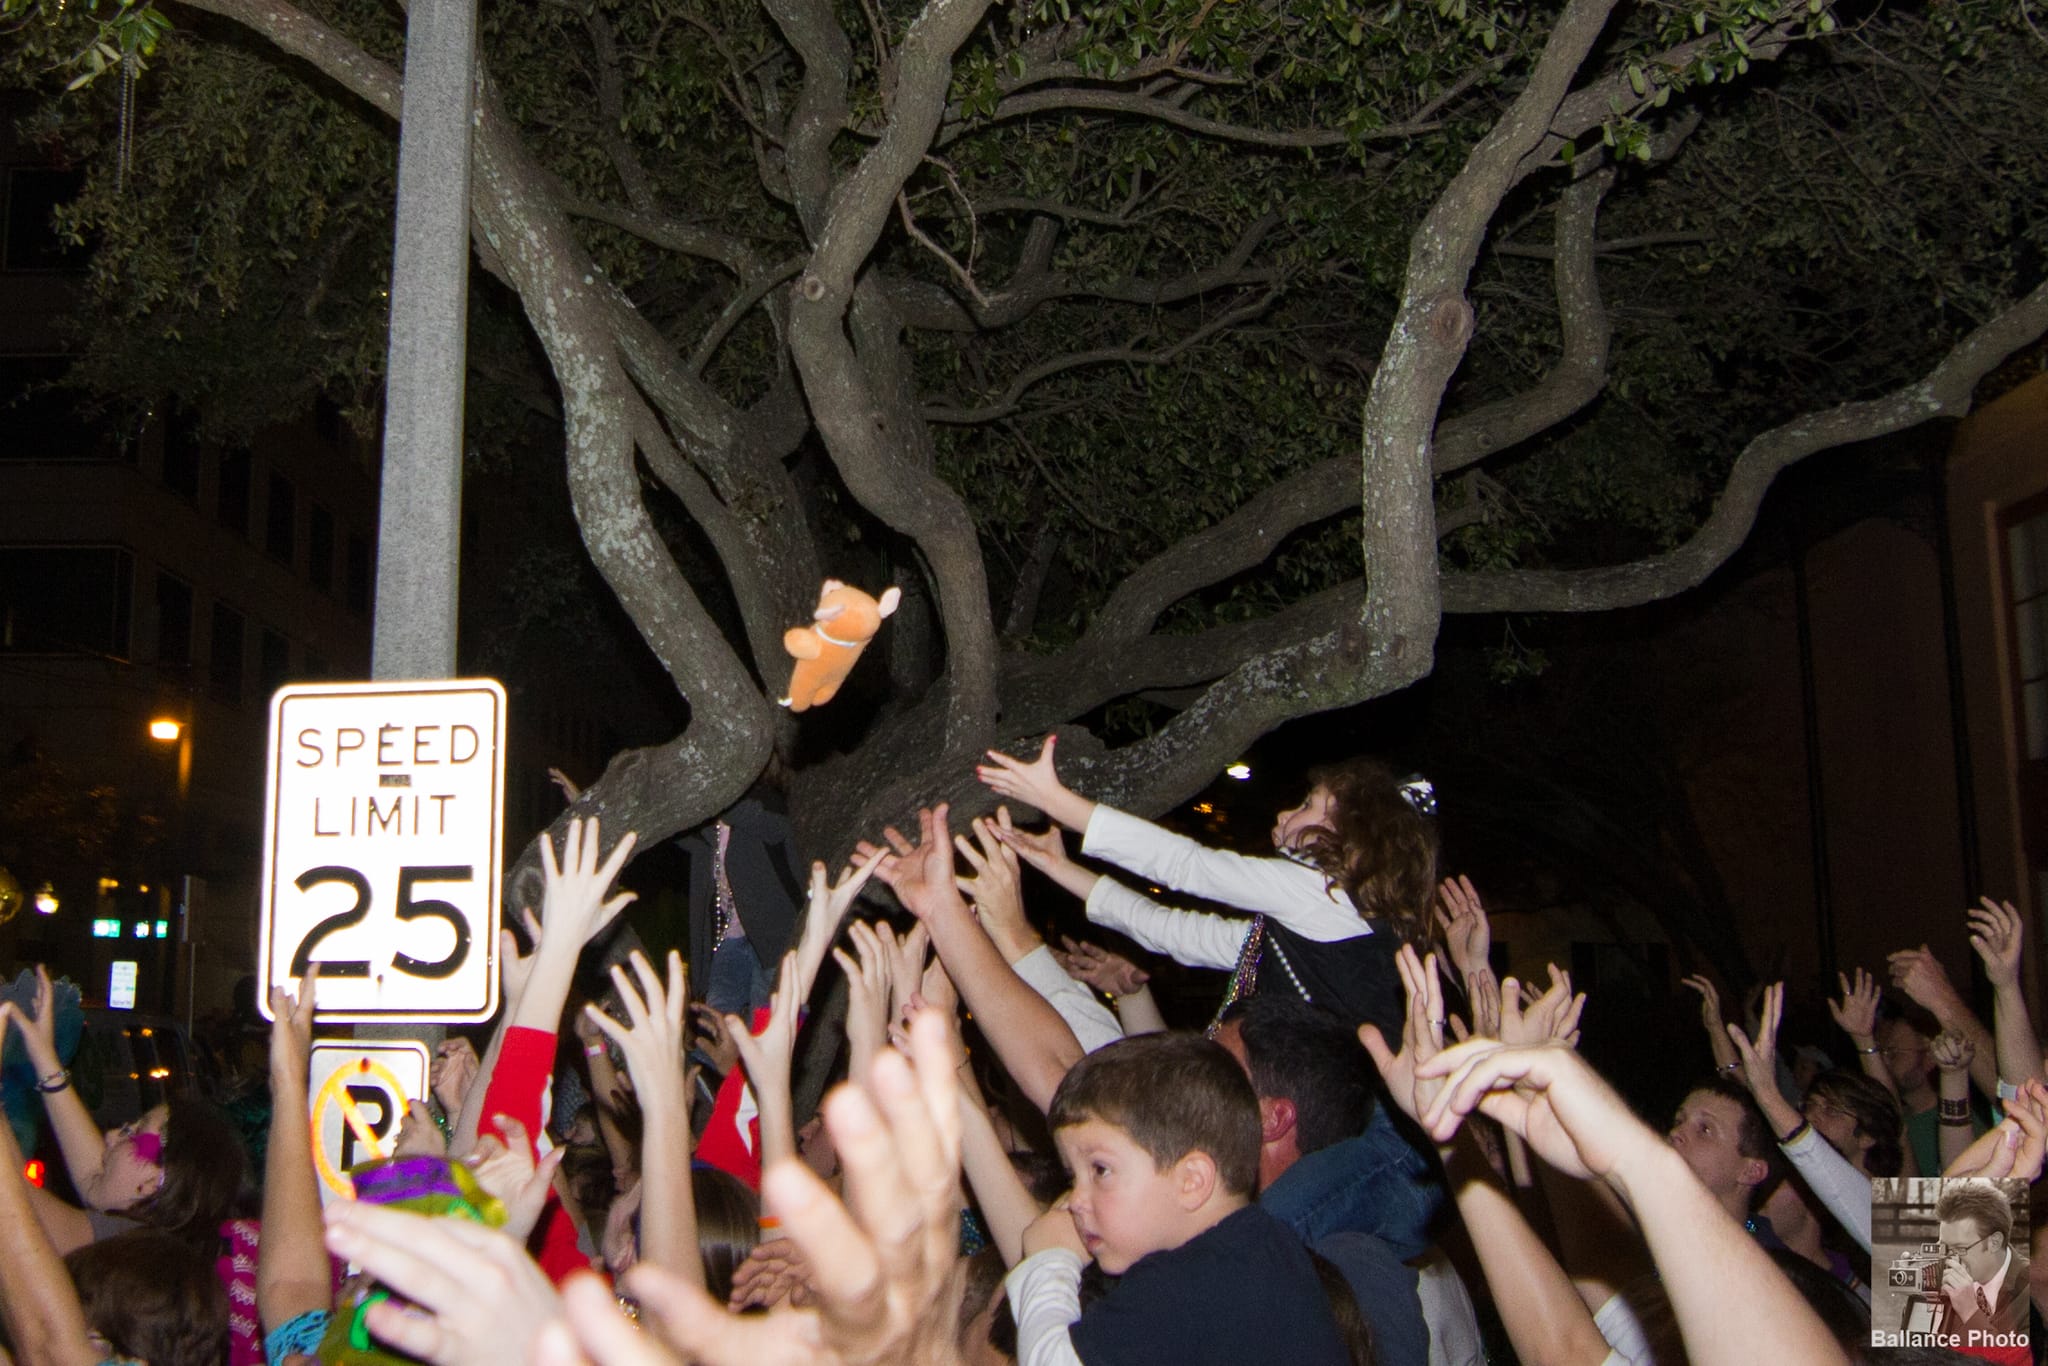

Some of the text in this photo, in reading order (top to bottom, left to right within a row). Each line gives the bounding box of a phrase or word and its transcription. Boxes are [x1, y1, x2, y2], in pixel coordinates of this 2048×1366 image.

[296, 724, 479, 768] SPEED
[314, 795, 456, 837] LIMIT
[290, 865, 473, 980] 25
[341, 1084, 393, 1172] P
